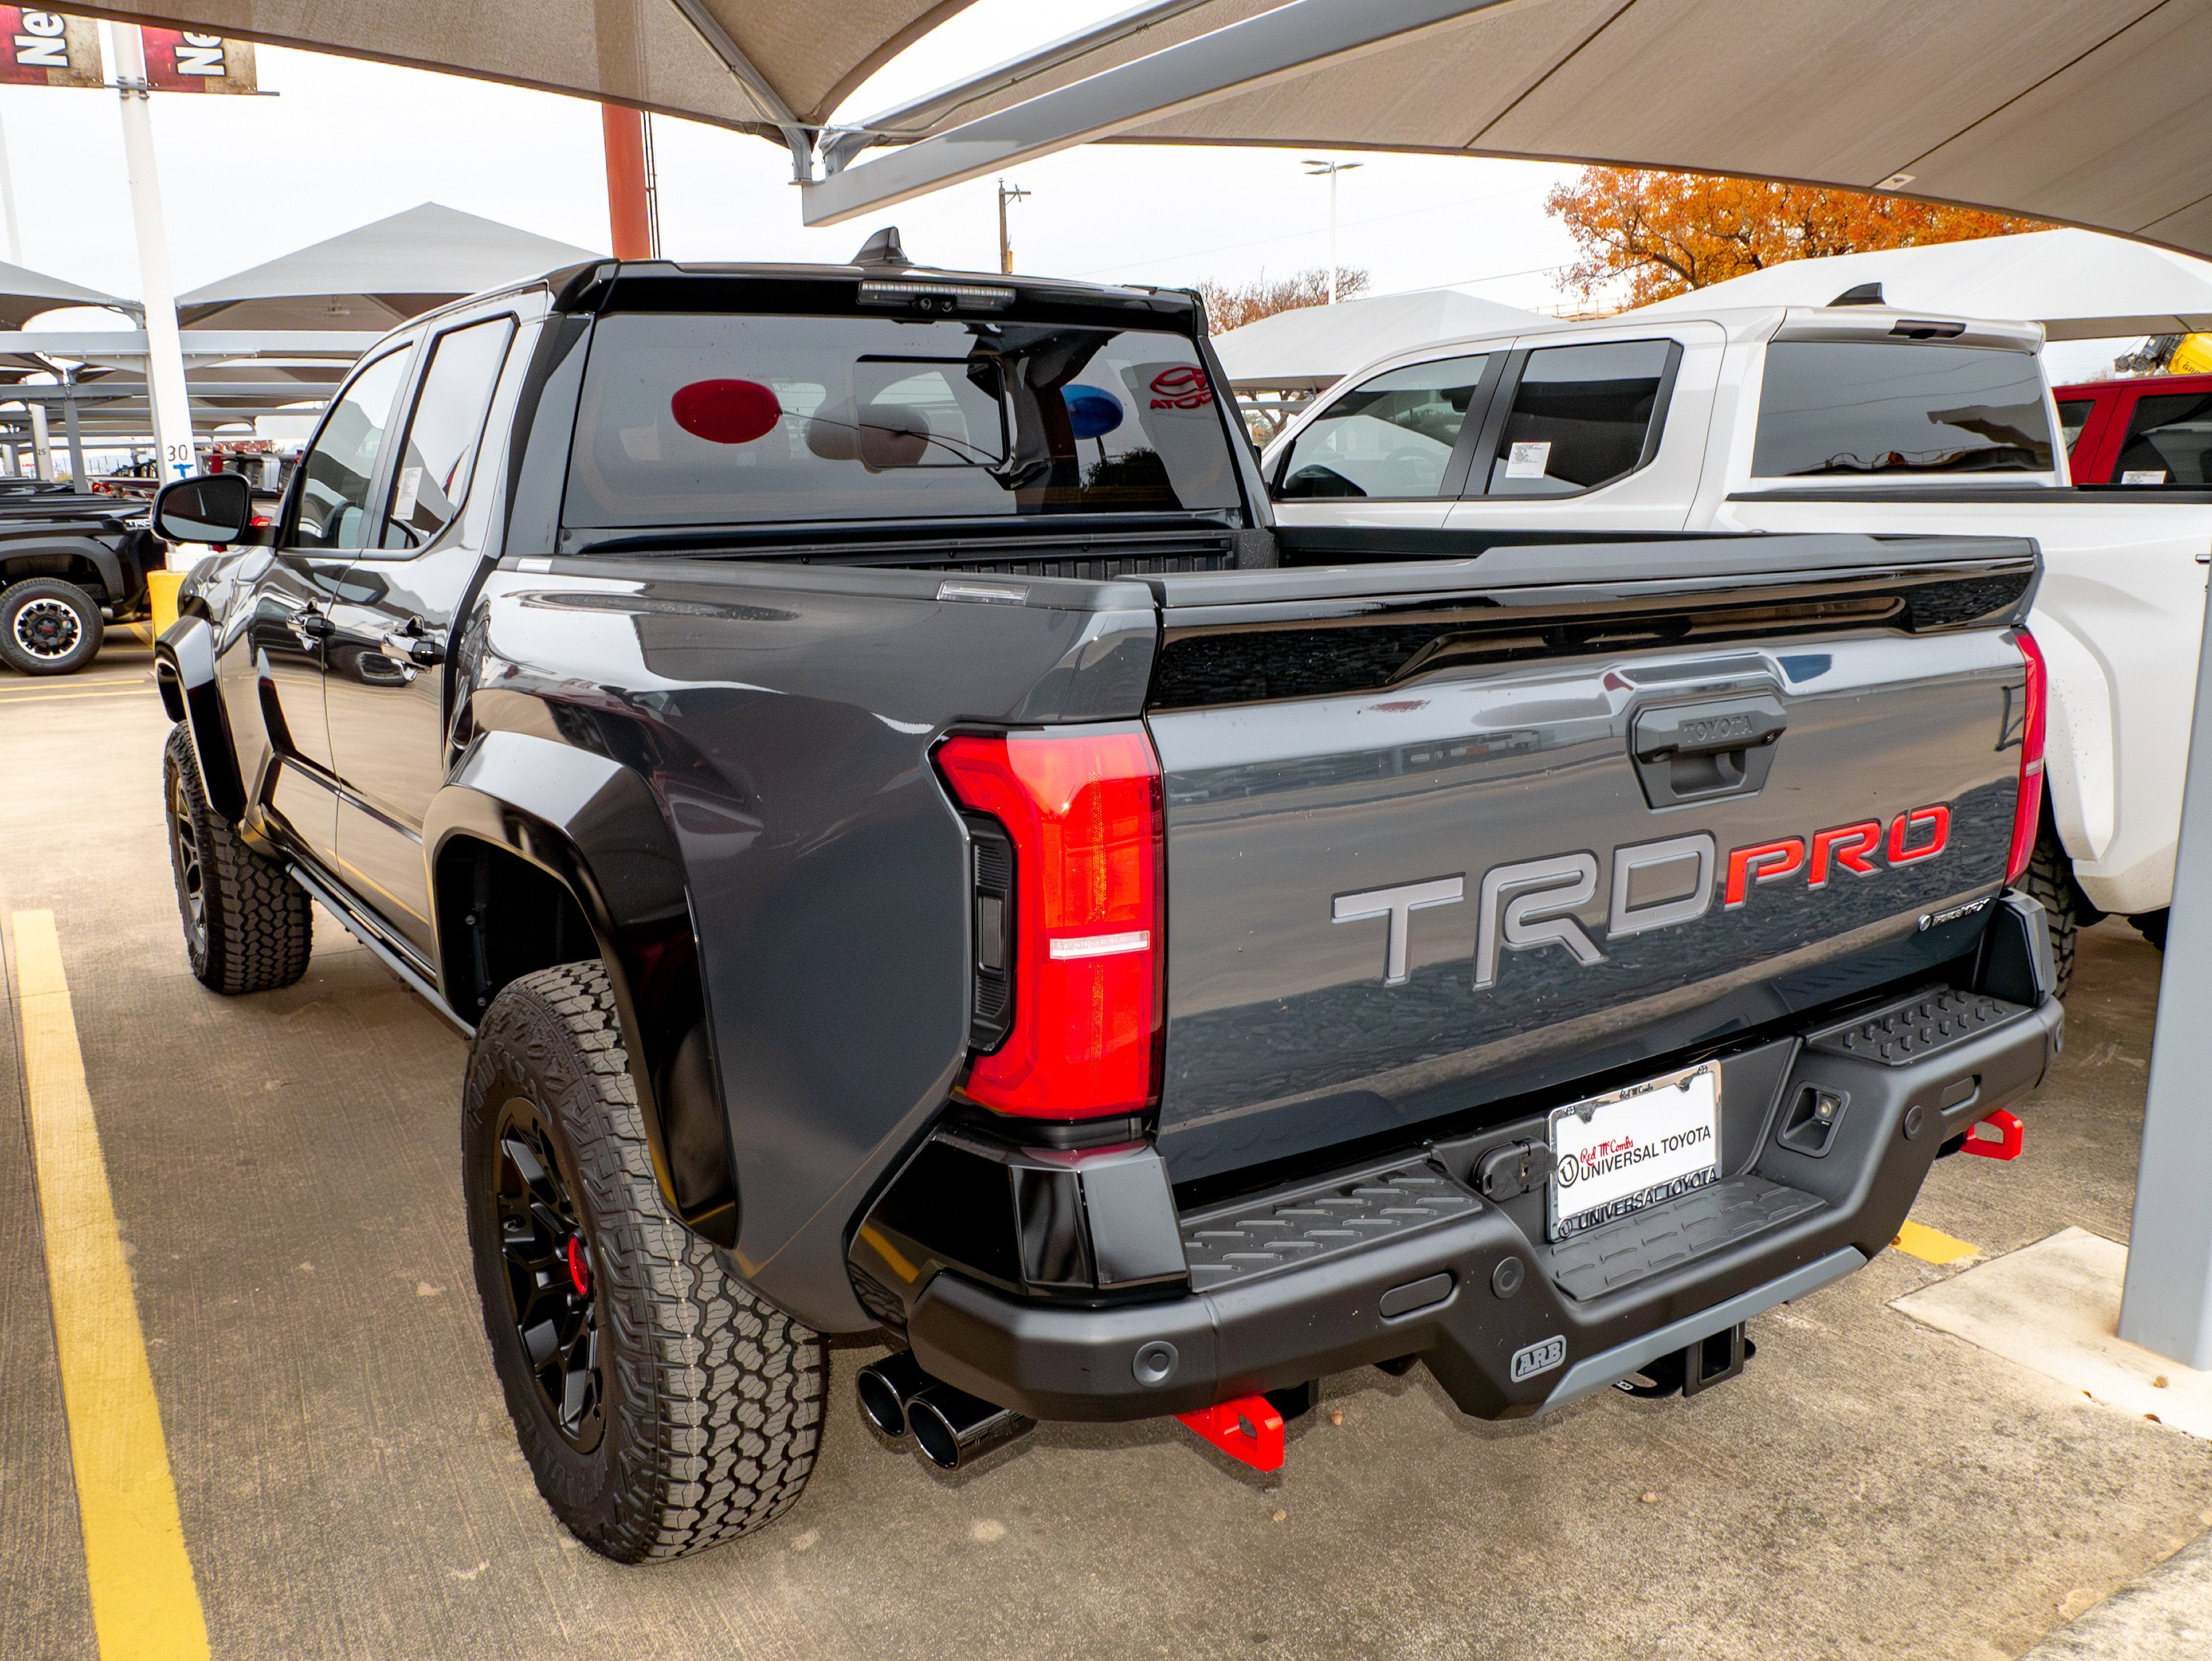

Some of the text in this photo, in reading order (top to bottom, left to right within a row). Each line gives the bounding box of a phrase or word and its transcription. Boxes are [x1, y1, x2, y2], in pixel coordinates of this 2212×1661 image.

[167, 444, 188, 461] 30
[1683, 715, 1753, 743] TOYOTA
[1332, 802, 1952, 991] TRD PRO
[1581, 1136, 1634, 1166] Red McCombs
[1581, 1125, 1711, 1181] UNIVERSAL TOYOTA
[1578, 1167, 1717, 1230] UNIVERSAL TOYOTA
[1518, 1342, 1561, 1376] ARB
